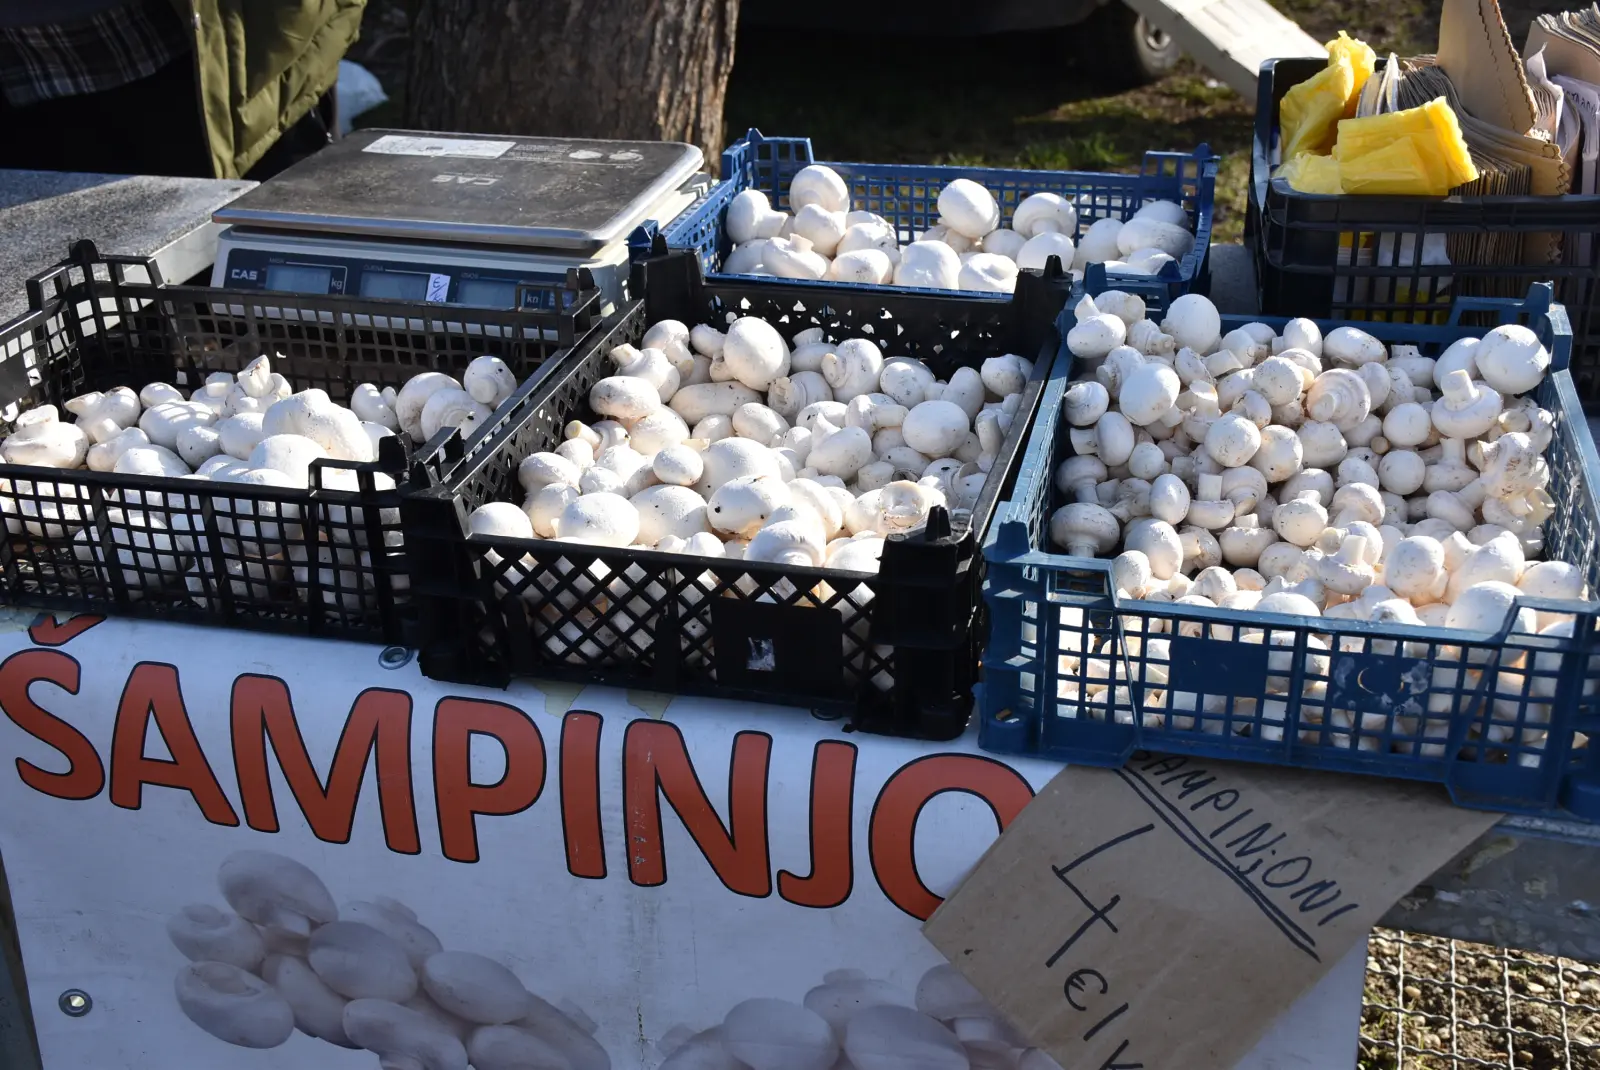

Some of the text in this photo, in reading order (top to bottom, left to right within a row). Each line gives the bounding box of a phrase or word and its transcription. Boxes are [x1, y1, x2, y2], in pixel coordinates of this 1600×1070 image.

[231, 268, 258, 280] CAS
[331, 277, 343, 290] kg
[526, 293, 539, 304] kn
